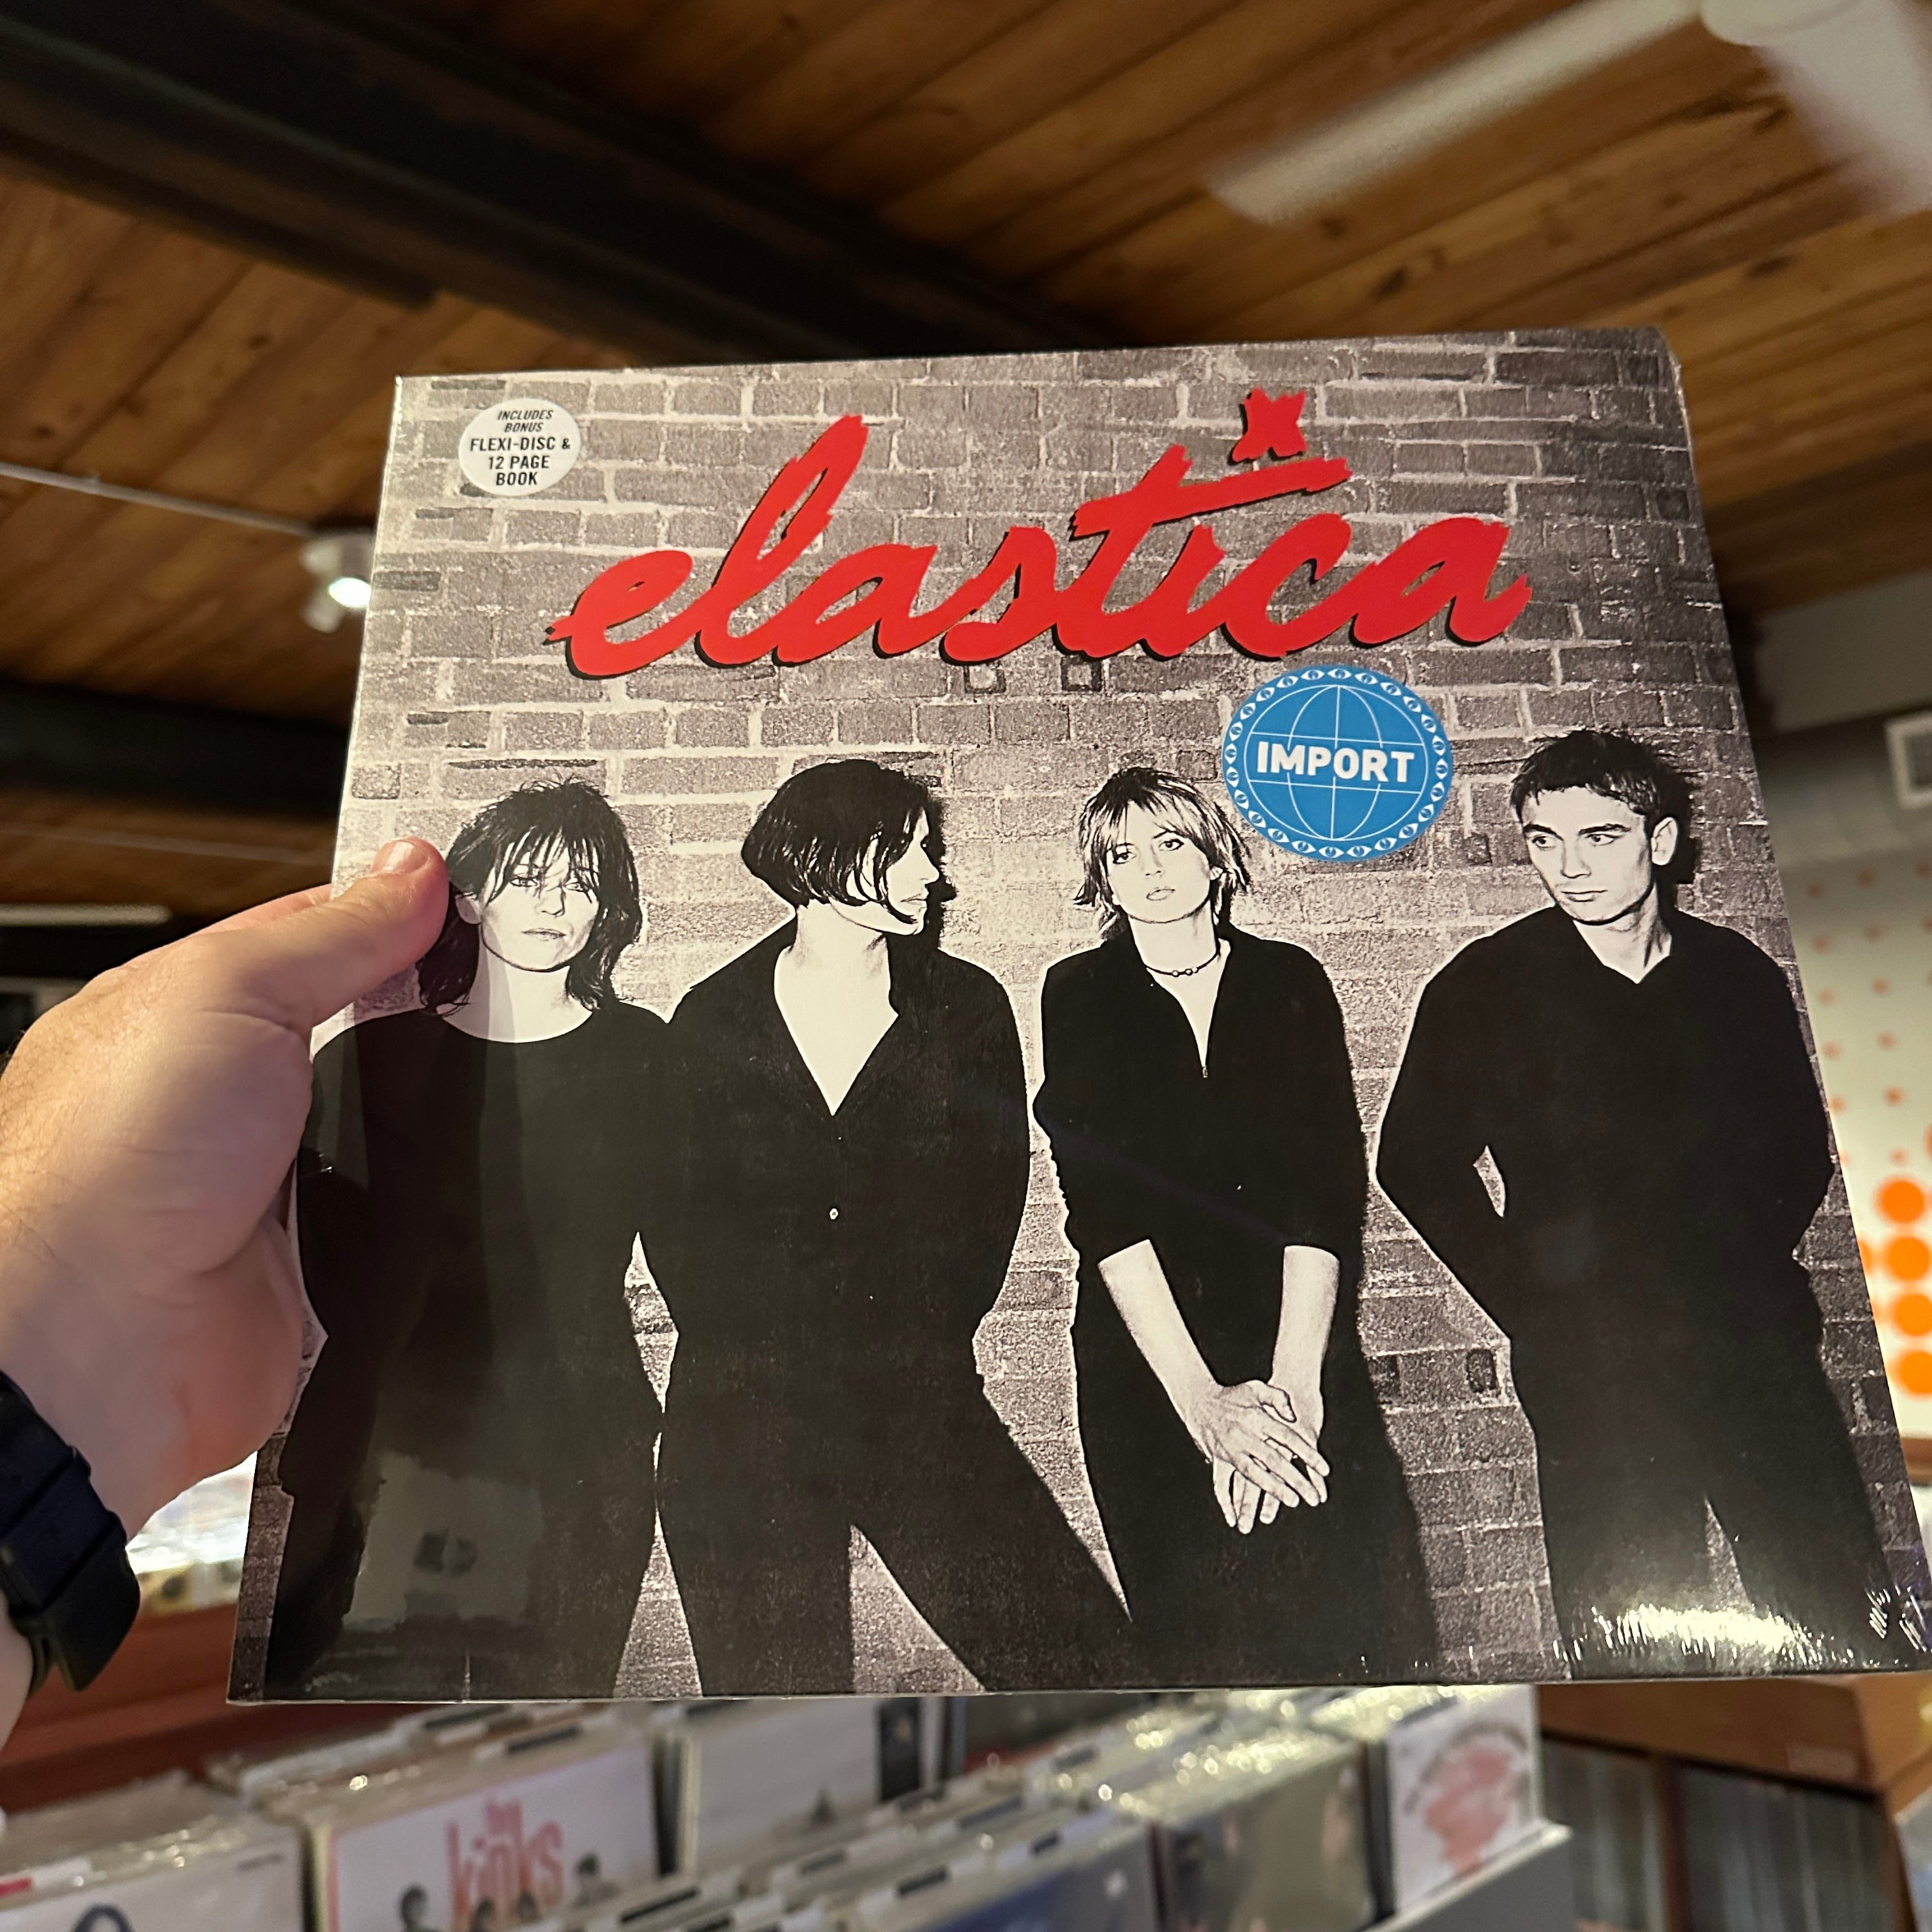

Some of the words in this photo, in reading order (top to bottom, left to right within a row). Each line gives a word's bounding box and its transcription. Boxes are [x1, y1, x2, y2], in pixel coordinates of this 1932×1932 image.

[498, 410, 554, 420] INCLUDES
[504, 422, 544, 433] BONUS
[470, 436, 556, 452] FLEXI-DISC
[562, 438, 571, 450] &
[489, 456, 505, 470] 12
[509, 455, 550, 470] PAGE
[496, 471, 538, 486] BOOK
[548, 388, 1533, 677] elastica
[1257, 741, 1415, 783] IMPORT
